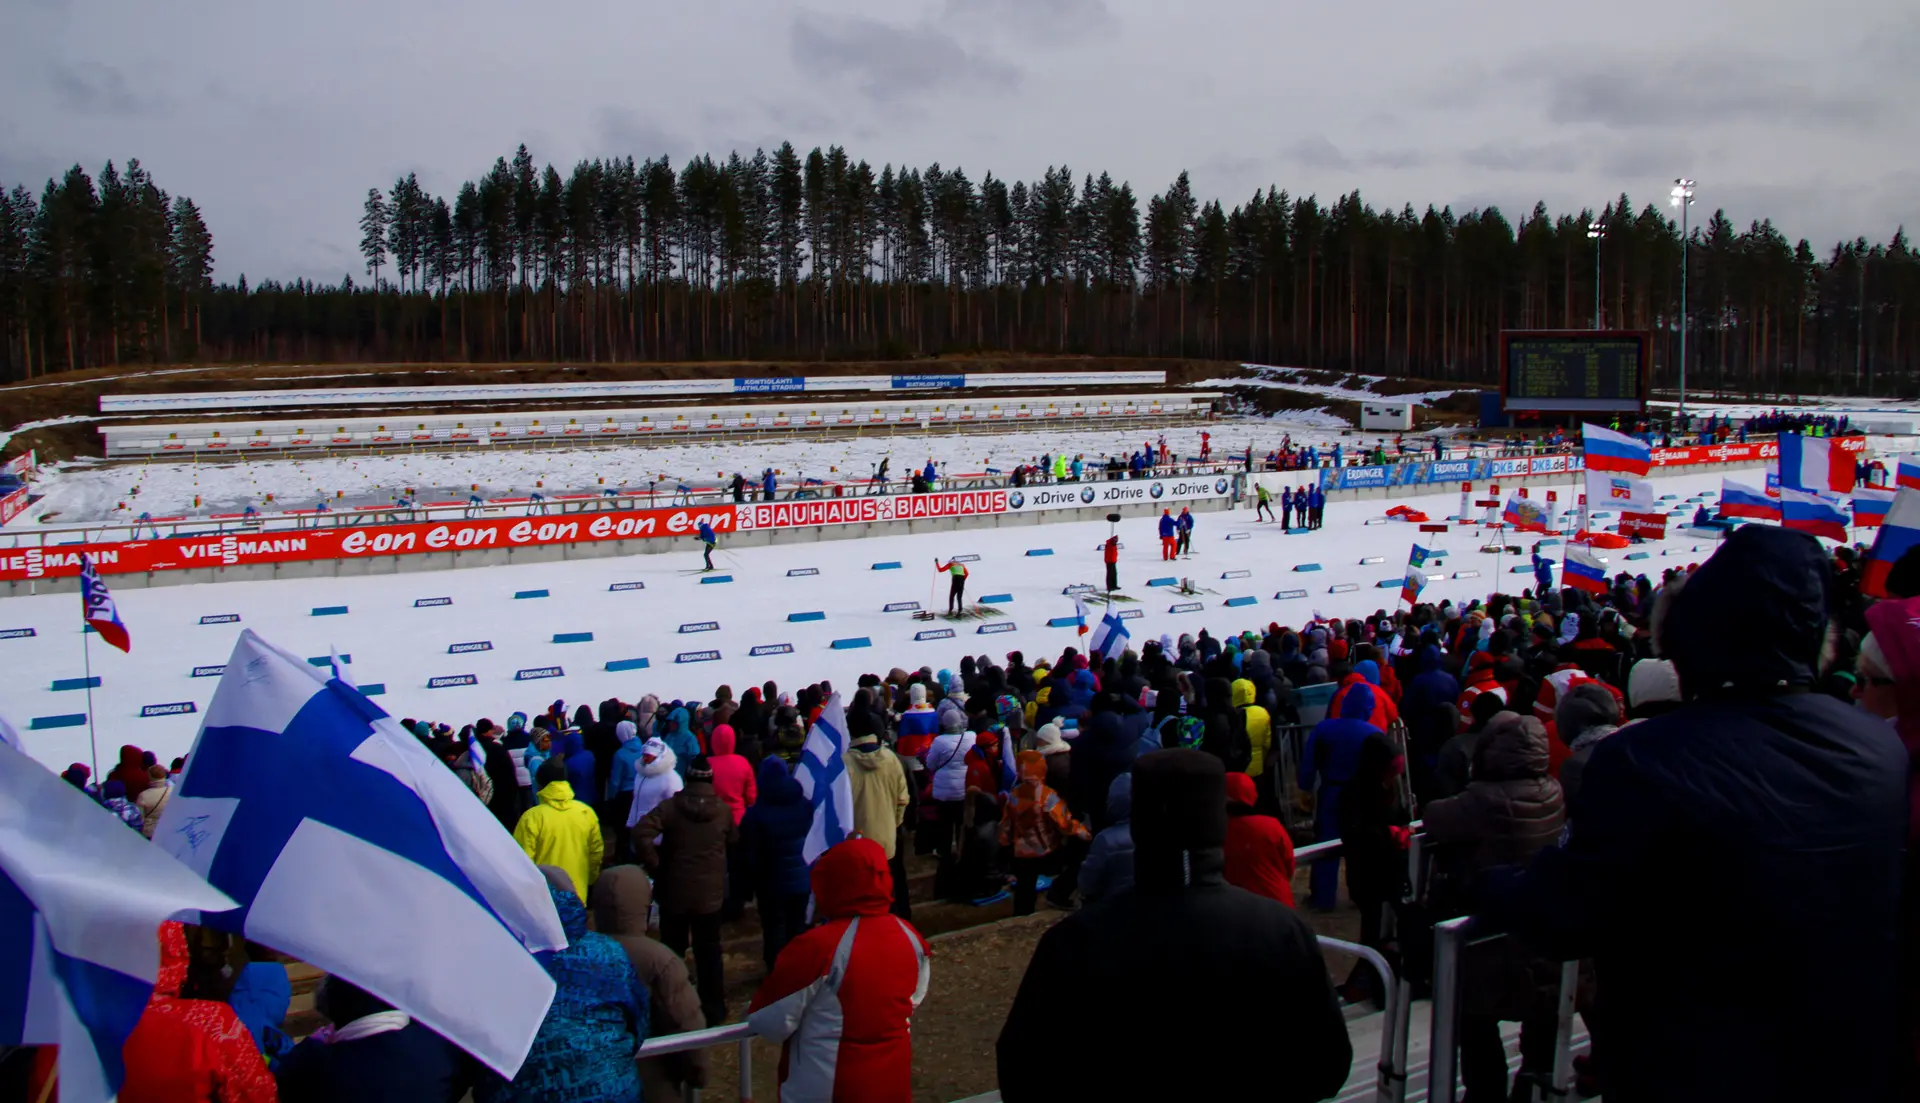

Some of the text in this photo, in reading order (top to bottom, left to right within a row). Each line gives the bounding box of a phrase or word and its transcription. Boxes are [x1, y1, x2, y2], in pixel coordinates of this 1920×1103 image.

[1651, 449, 1690, 465] IESSMANN
[1433, 463, 1470, 474] ERDINGER
[1492, 461, 1528, 474] DKB.de
[1531, 459, 1566, 471] DKB.de
[1346, 467, 1384, 479] ERDINGER
[1033, 482, 1209, 505] xDrive xDrive xDrive
[757, 493, 1006, 525] BAUHAUS BAUHAUS
[179, 537, 306, 564] VIESSMANN
[0, 549, 118, 577] IESSMANN
[452, 643, 482, 652] ERDINGER
[755, 646, 783, 655] ERDINGER
[680, 653, 711, 661] ERDINGER
[521, 669, 553, 678] ERDINGER
[432, 677, 466, 687] ERDINGER
[145, 705, 182, 715] ERDINGER
